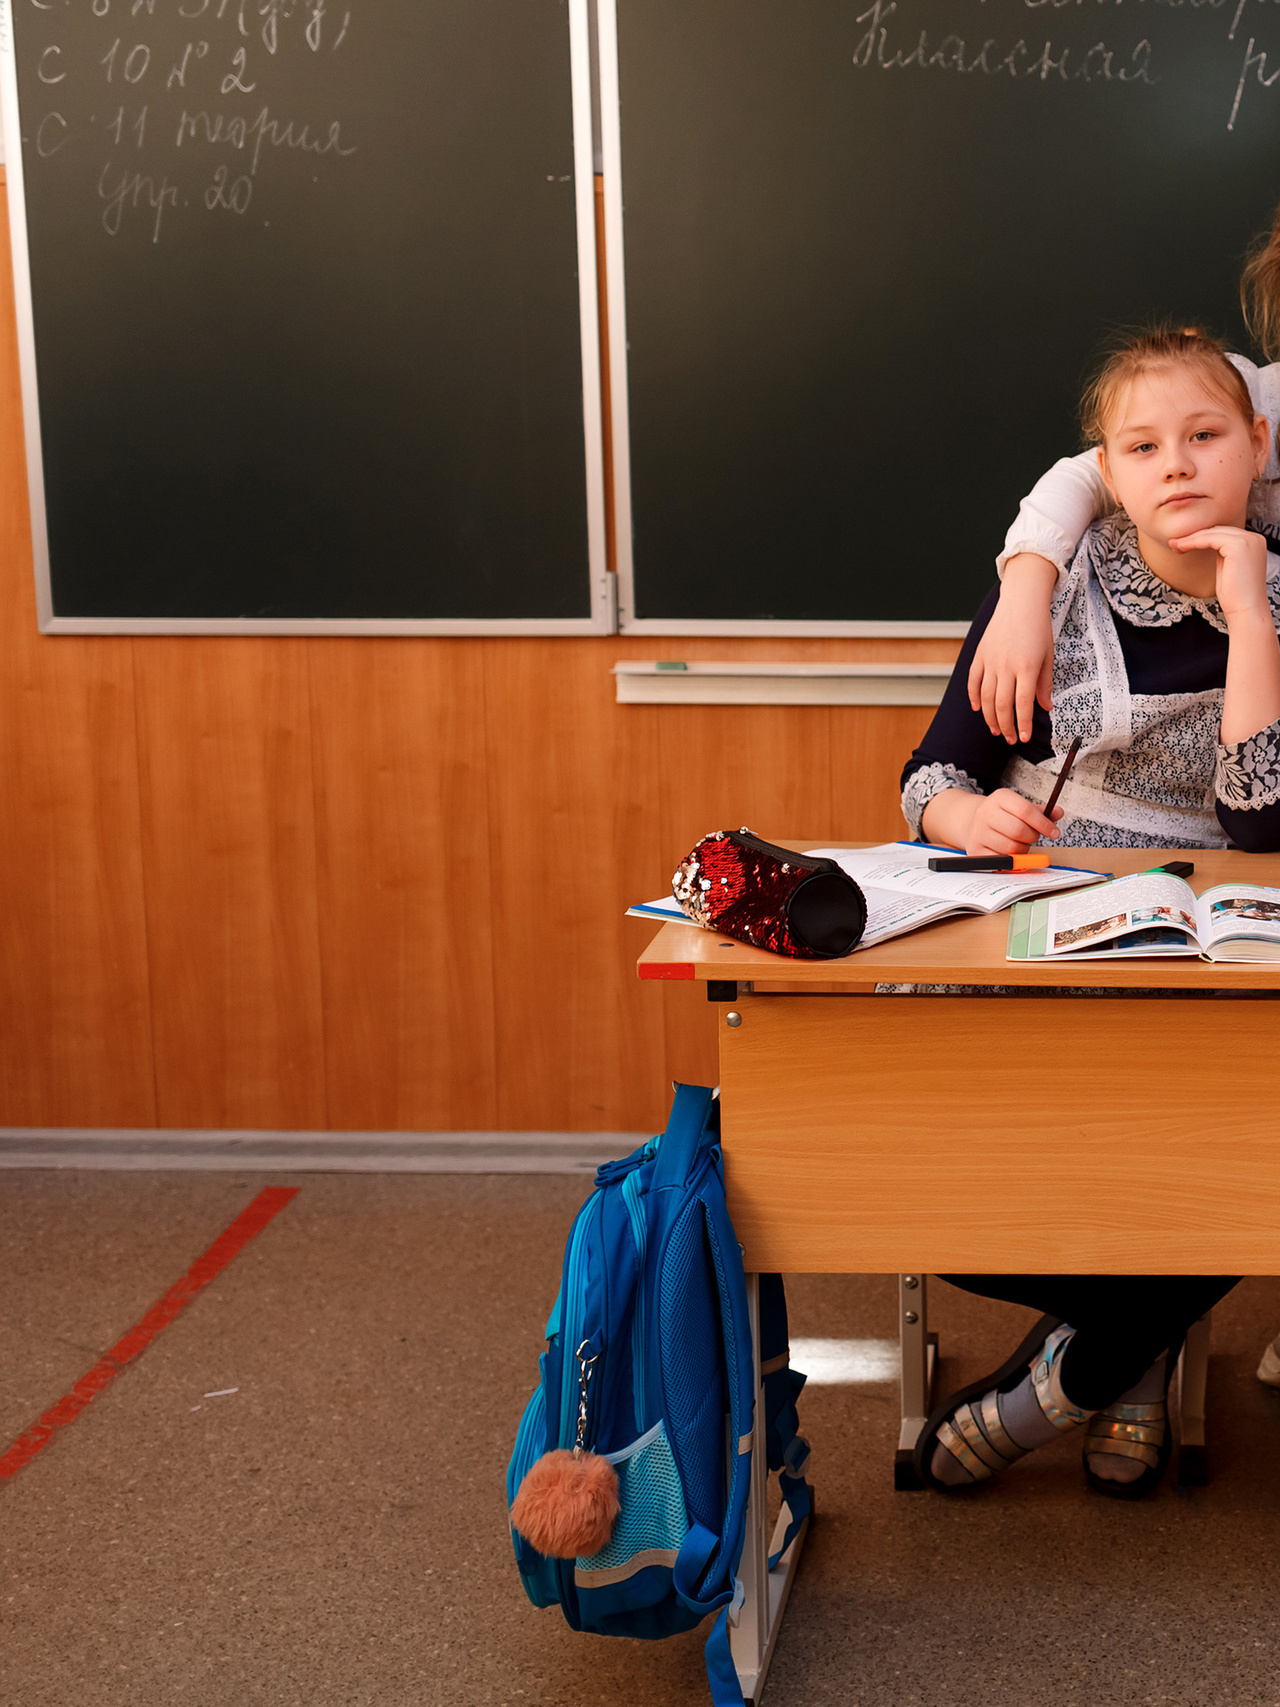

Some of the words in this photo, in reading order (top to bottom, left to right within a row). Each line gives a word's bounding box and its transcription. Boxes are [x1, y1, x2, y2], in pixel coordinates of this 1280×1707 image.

[100, 38, 152, 84] 10
[221, 46, 256, 94] 2
[852, 0, 1162, 85] Классная
[106, 105, 148, 148] 11
[176, 106, 356, 175] теория
[204, 164, 253, 215] 20
